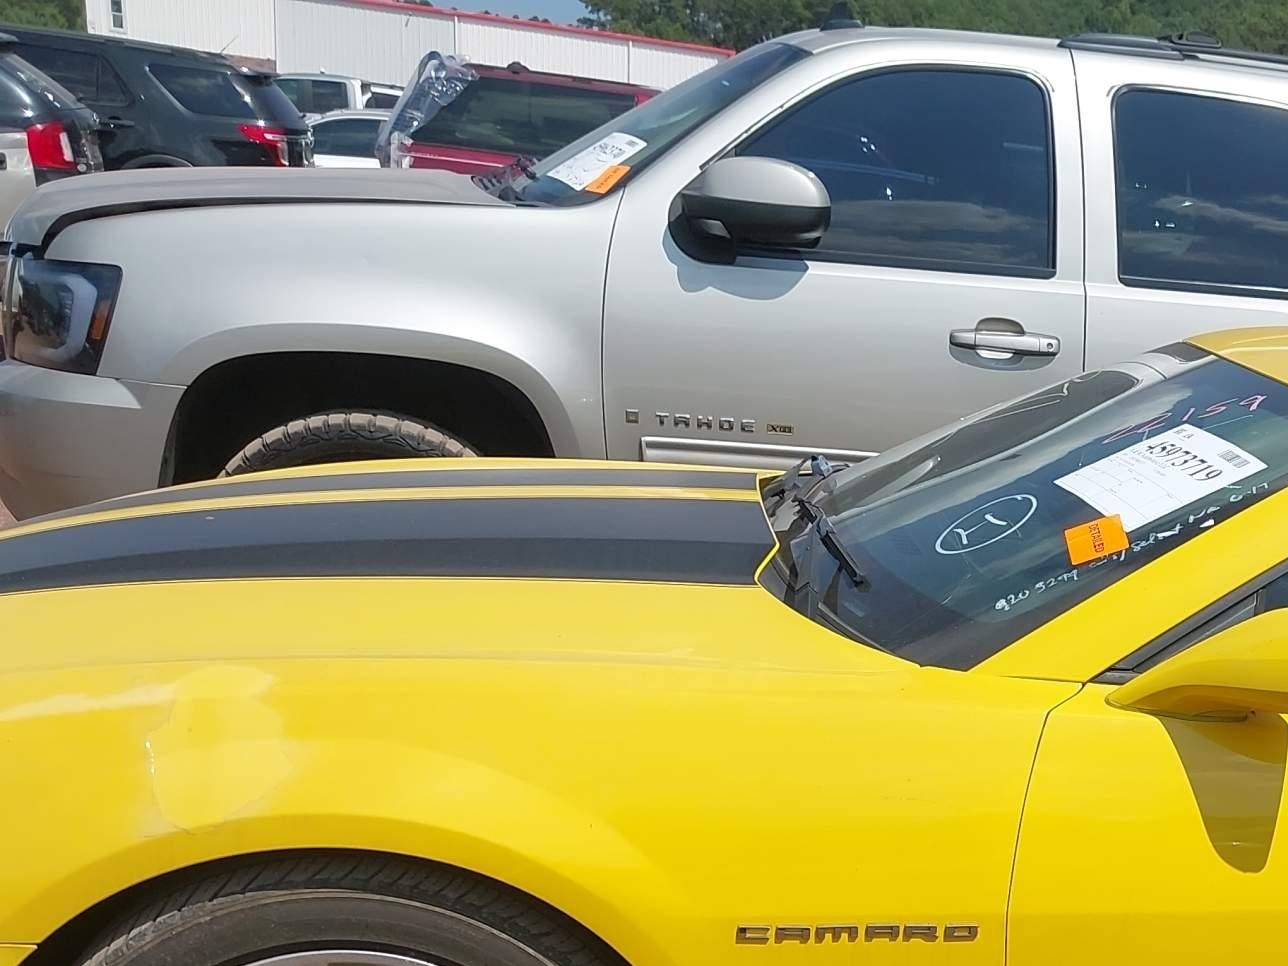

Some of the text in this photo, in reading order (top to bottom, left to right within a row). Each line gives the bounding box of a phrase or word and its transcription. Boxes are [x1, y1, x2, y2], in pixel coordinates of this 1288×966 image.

[656, 412, 756, 433] TAHOE
[1144, 439, 1223, 482] 45973719
[1087, 523, 1105, 554] DETAILED
[736, 925, 979, 945] CAMARO
